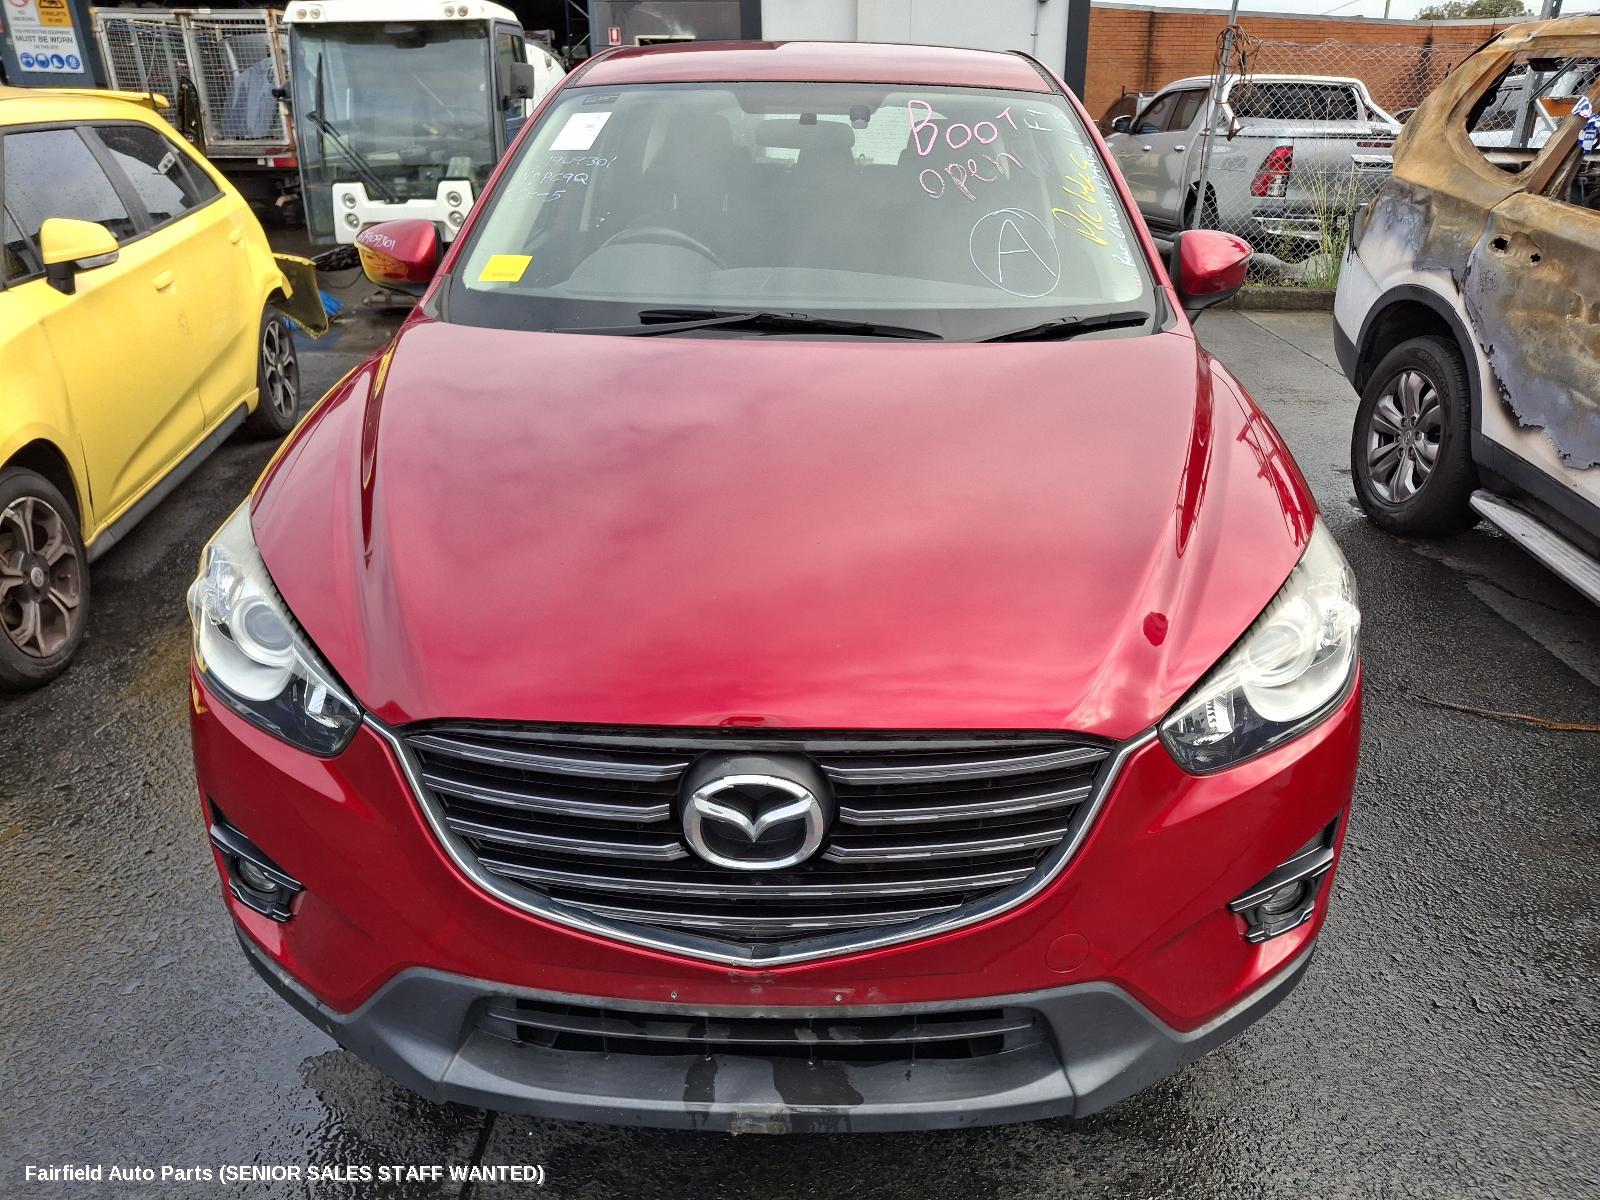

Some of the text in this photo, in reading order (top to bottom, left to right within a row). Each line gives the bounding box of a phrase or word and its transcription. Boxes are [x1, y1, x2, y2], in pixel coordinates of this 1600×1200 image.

[15, 35, 36, 43] MUST
[51, 36, 74, 44] WORN
[998, 218, 1058, 285] A
